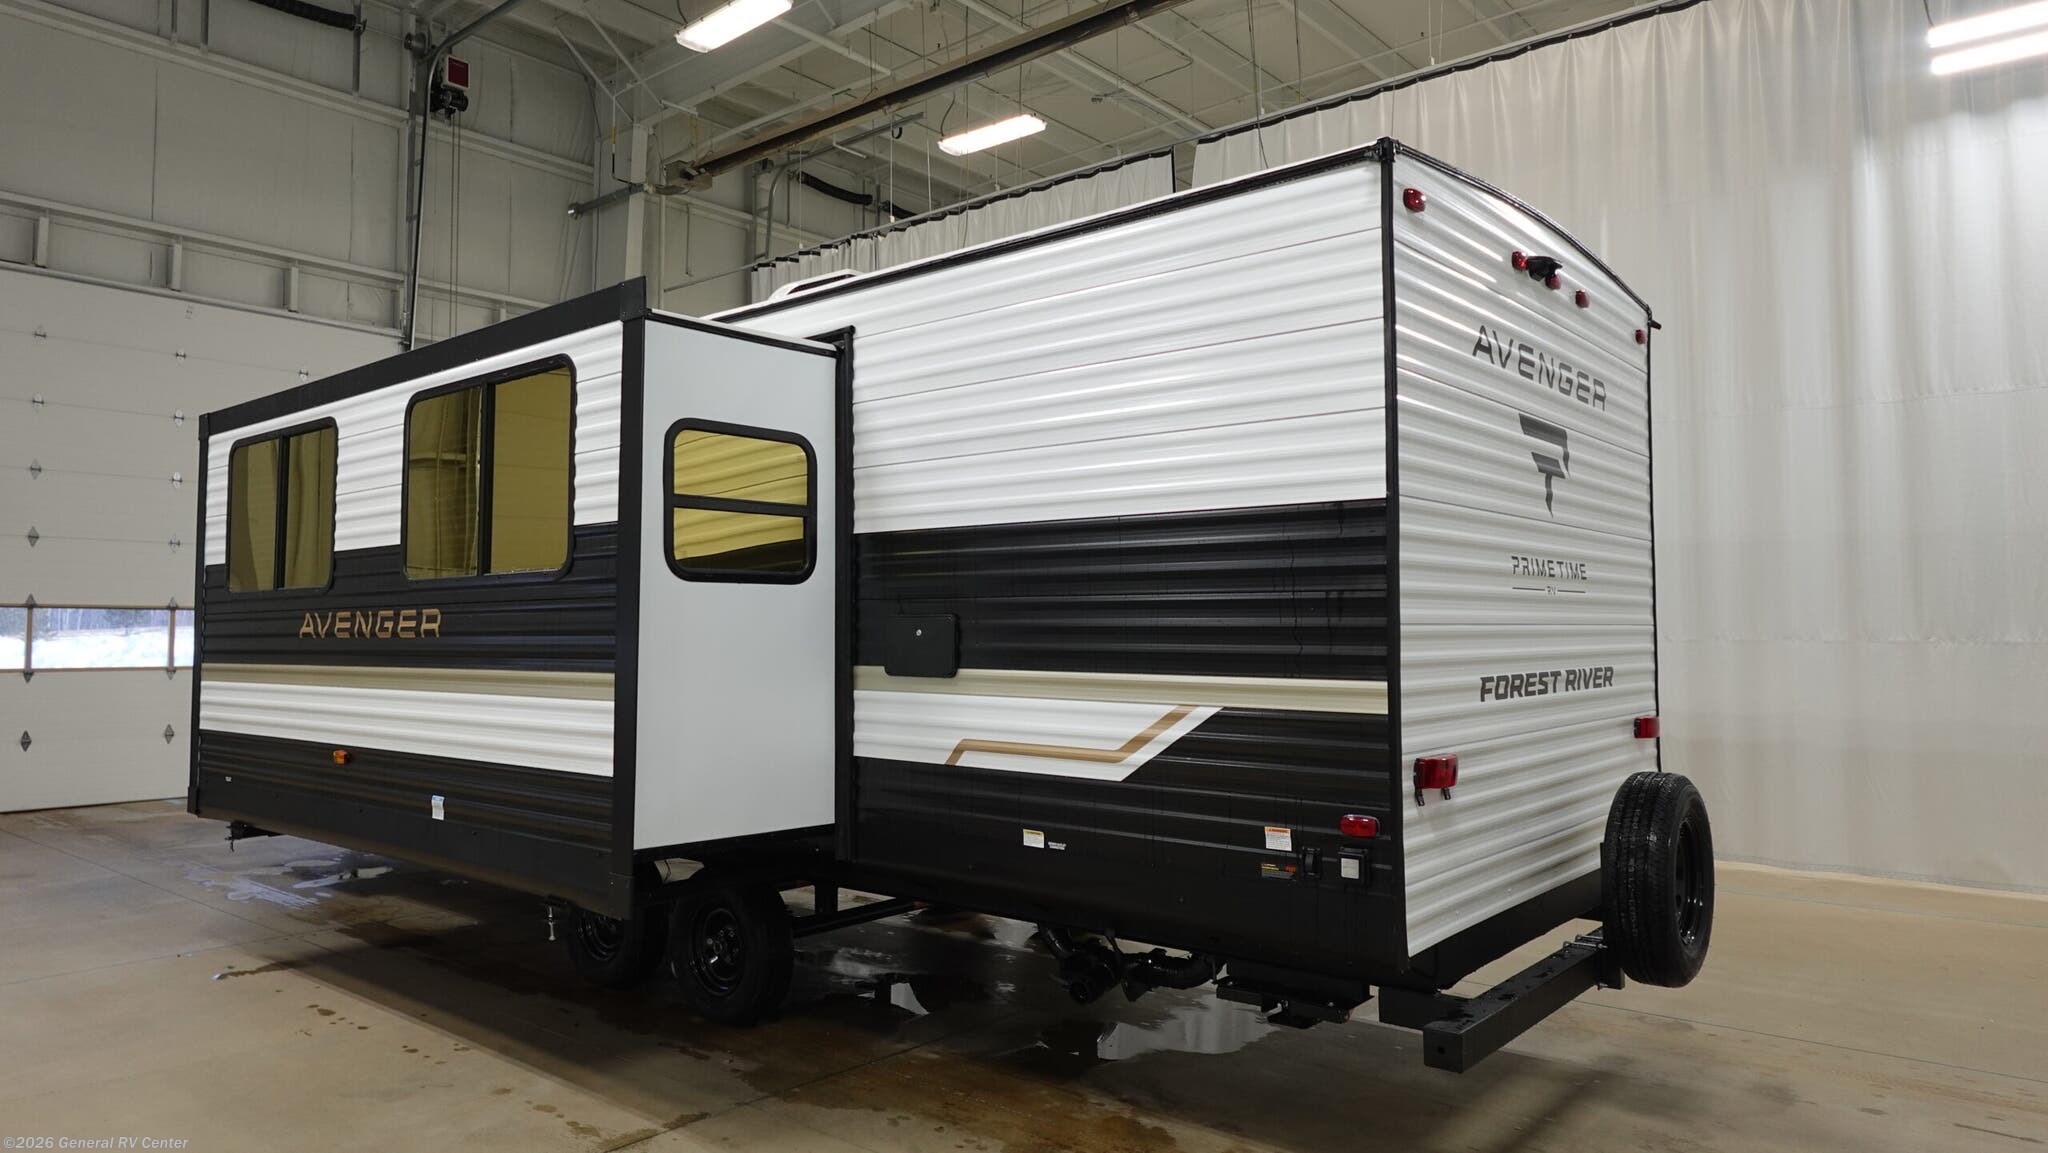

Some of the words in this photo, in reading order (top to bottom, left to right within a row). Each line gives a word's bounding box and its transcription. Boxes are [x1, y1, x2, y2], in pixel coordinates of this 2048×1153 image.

[1472, 325, 1606, 411] AVENGER
[299, 608, 442, 638] AVENGER
[1480, 670, 1561, 702] FOREST
[1565, 666, 1614, 692] RIVER
